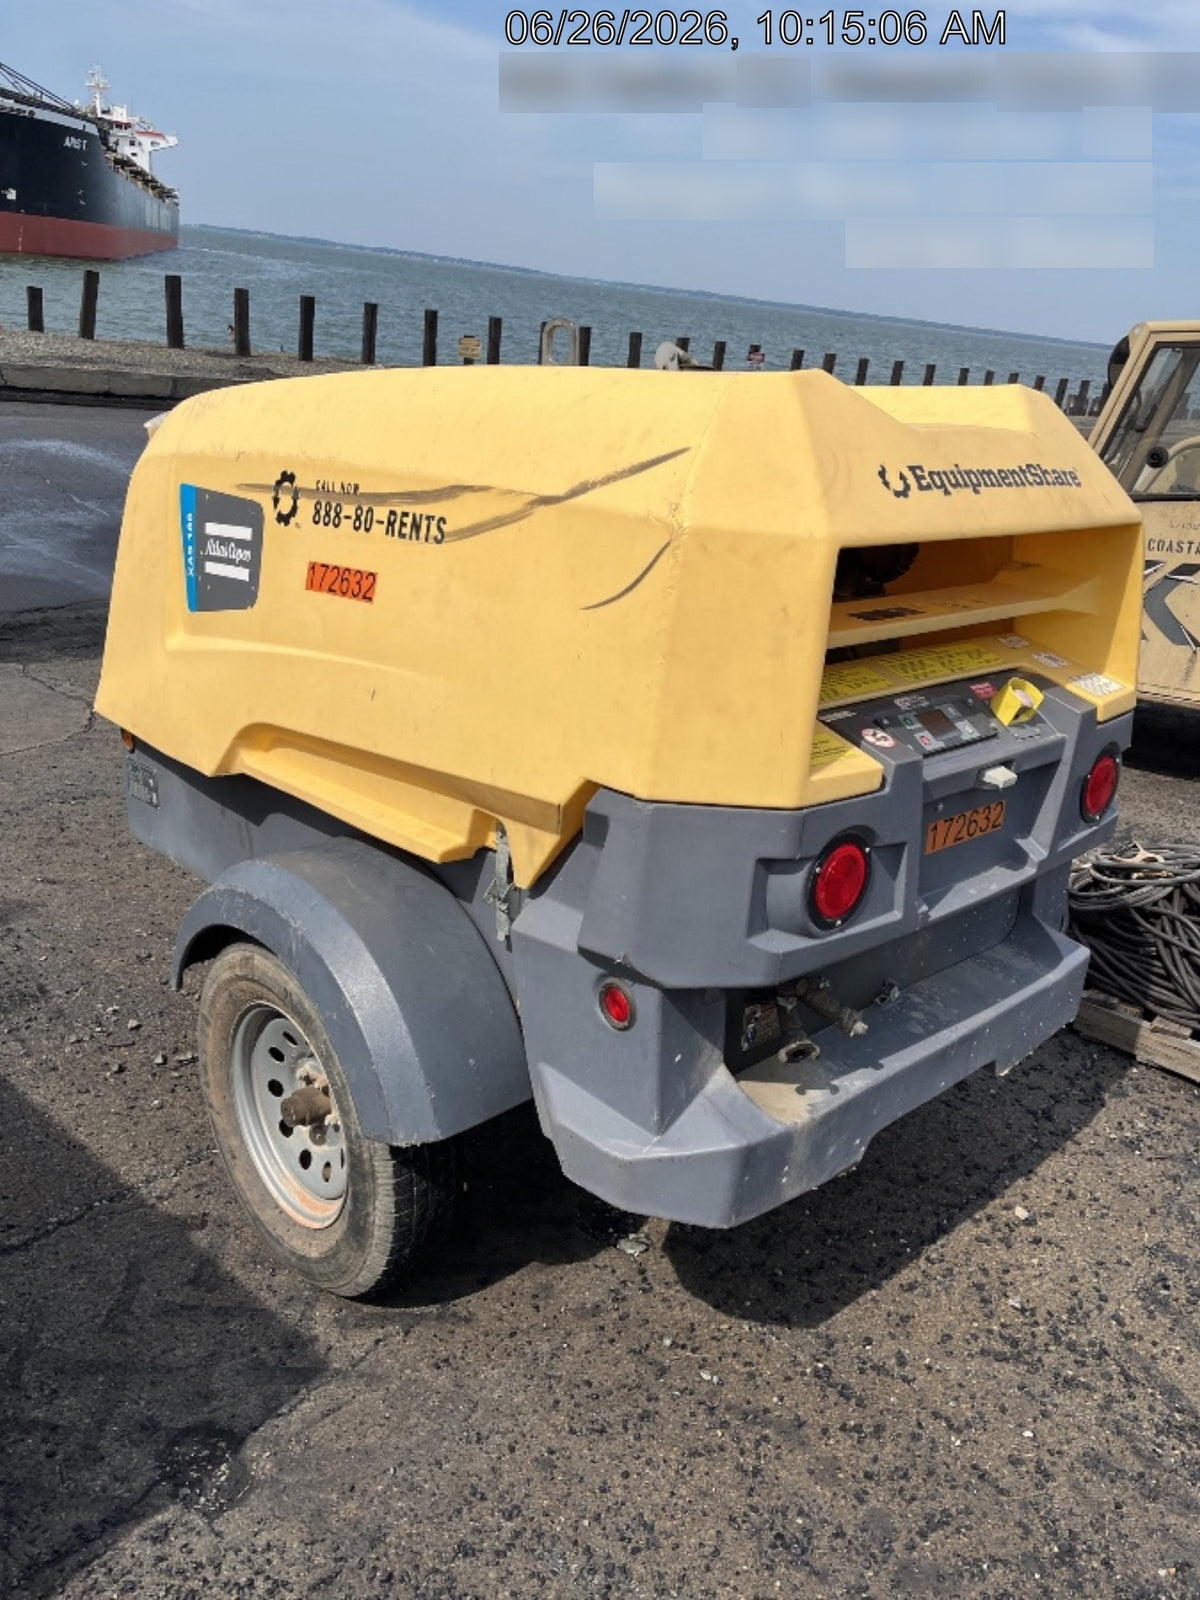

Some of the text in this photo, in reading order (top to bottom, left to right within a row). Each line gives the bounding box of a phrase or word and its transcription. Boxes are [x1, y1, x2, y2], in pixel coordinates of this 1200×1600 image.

[315, 479, 360, 496] CALL NOW
[907, 463, 1082, 496] EquipmentShare
[312, 500, 447, 545] 888-80-RENTS
[203, 538, 228, 557] Atlas
[307, 560, 377, 602] 172632
[930, 800, 1004, 851] 172632
